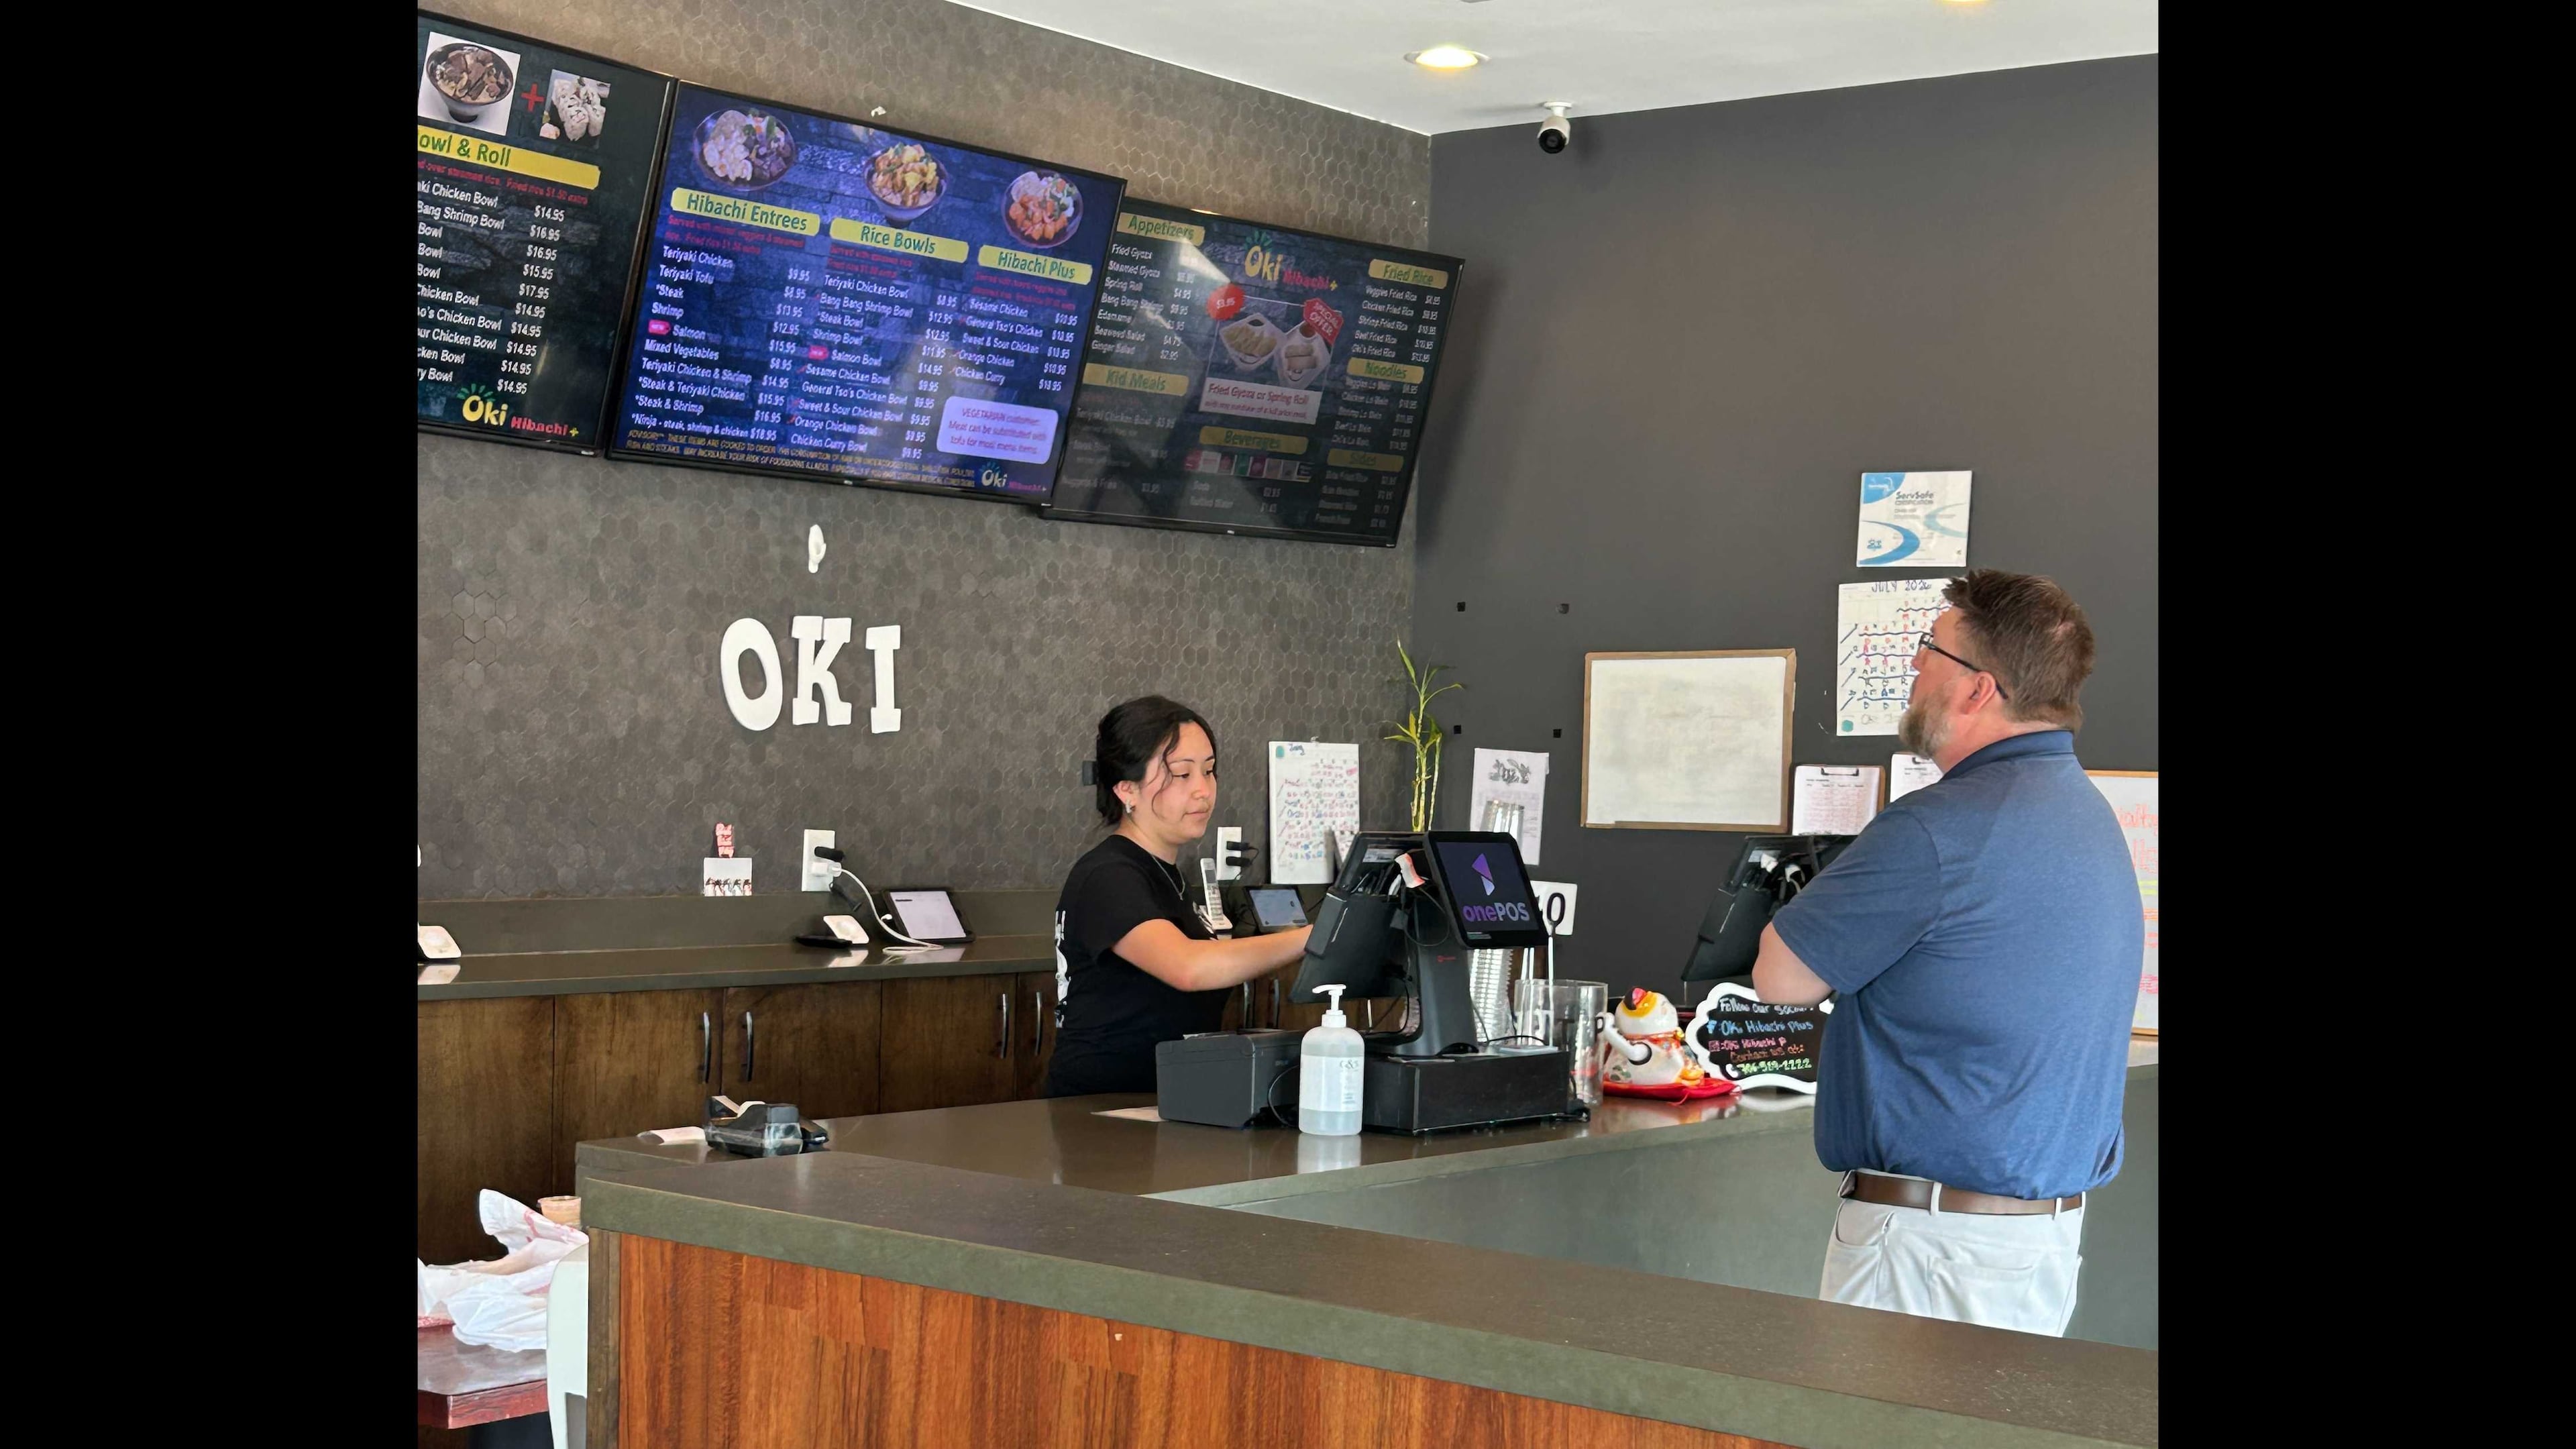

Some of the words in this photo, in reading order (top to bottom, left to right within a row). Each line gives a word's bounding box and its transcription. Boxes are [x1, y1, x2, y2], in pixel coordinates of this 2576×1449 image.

[456, 138, 470, 158] &
[476, 143, 511, 166] Roll
[431, 182, 471, 201] Chicken
[473, 191, 498, 207] Bowl
[417, 200, 441, 219] Bang
[443, 206, 478, 227] Shrimp
[480, 214, 504, 229] Bowl
[534, 205, 564, 221] $14.95
[687, 193, 747, 219] Hibachi
[750, 205, 806, 230] Entrees
[417, 221, 443, 237] Bowl
[529, 224, 559, 241] $16.95
[1128, 216, 1195, 241] Appetizers
[860, 225, 890, 245] Rice
[894, 231, 935, 254] Bowls
[417, 242, 443, 258] Bowl
[526, 244, 557, 260] $16.95
[663, 245, 697, 262] Teriyaki
[698, 252, 733, 268] Chicken
[1111, 244, 1130, 256] Fried
[417, 262, 441, 278] Bowl
[523, 263, 553, 280] $15.95
[998, 251, 1046, 274] Hibachi
[1049, 261, 1075, 278] Plus
[1244, 246, 1283, 281] Oki
[659, 264, 694, 281] Teriyaki
[788, 268, 810, 281] $9.95
[1382, 264, 1411, 282] Fried
[1411, 268, 1435, 286] Rice
[519, 282, 549, 299] $17.95
[824, 274, 855, 290] Teriyaki
[856, 280, 887, 294] Chicken
[888, 286, 909, 298] Bowl
[454, 290, 479, 306] Bowl
[819, 292, 841, 309] Bang
[842, 296, 863, 312] Bang
[864, 300, 892, 317] Shrimp
[893, 305, 914, 317] Bowl
[515, 302, 545, 318] $14.95
[651, 301, 684, 319] Shrimp
[436, 308, 475, 325] Chicken
[477, 315, 502, 330] Bowl
[843, 315, 863, 327] Bowl
[511, 321, 541, 337] $14.95
[672, 324, 706, 339] Salmon
[773, 321, 799, 335] $12.95
[812, 328, 841, 344] Shrimp
[842, 332, 863, 345] Bowl
[431, 328, 471, 345] Chicken
[472, 335, 497, 350] Bowl
[769, 339, 796, 354] $15.95
[440, 349, 465, 364] Bowl
[506, 341, 537, 356] $14.95
[644, 339, 672, 353] Mixed
[673, 343, 718, 360] Vegetables
[500, 360, 531, 375] $14.95
[861, 354, 882, 366] Bowl
[427, 367, 453, 381] Bowl
[642, 357, 676, 373] Teriyaki
[677, 362, 711, 377] Chicken
[712, 368, 719, 379] &
[721, 369, 751, 385] Shrimp
[838, 368, 869, 381] Chicken
[871, 372, 890, 385] Bowl
[1364, 361, 1408, 380] Noodles
[496, 378, 527, 394] $14.95
[761, 374, 788, 388] $14.95
[1106, 370, 1128, 386] Kid
[1130, 373, 1167, 391] Meals
[667, 380, 674, 391] &
[677, 381, 710, 397] Teriyaki
[710, 386, 745, 400] Chicken
[855, 388, 887, 402] Chicken
[888, 393, 908, 405] Bowl
[462, 396, 509, 427] Oki
[663, 398, 671, 409] &
[673, 399, 704, 415] Shrimp
[851, 406, 883, 419] Chicken
[883, 410, 903, 421] Bowl
[790, 433, 822, 446] Chicken
[981, 470, 1007, 488] Oki
[1872, 581, 1897, 592] JULY
[720, 615, 902, 734] OKI
[1462, 902, 1530, 922] onePOS
